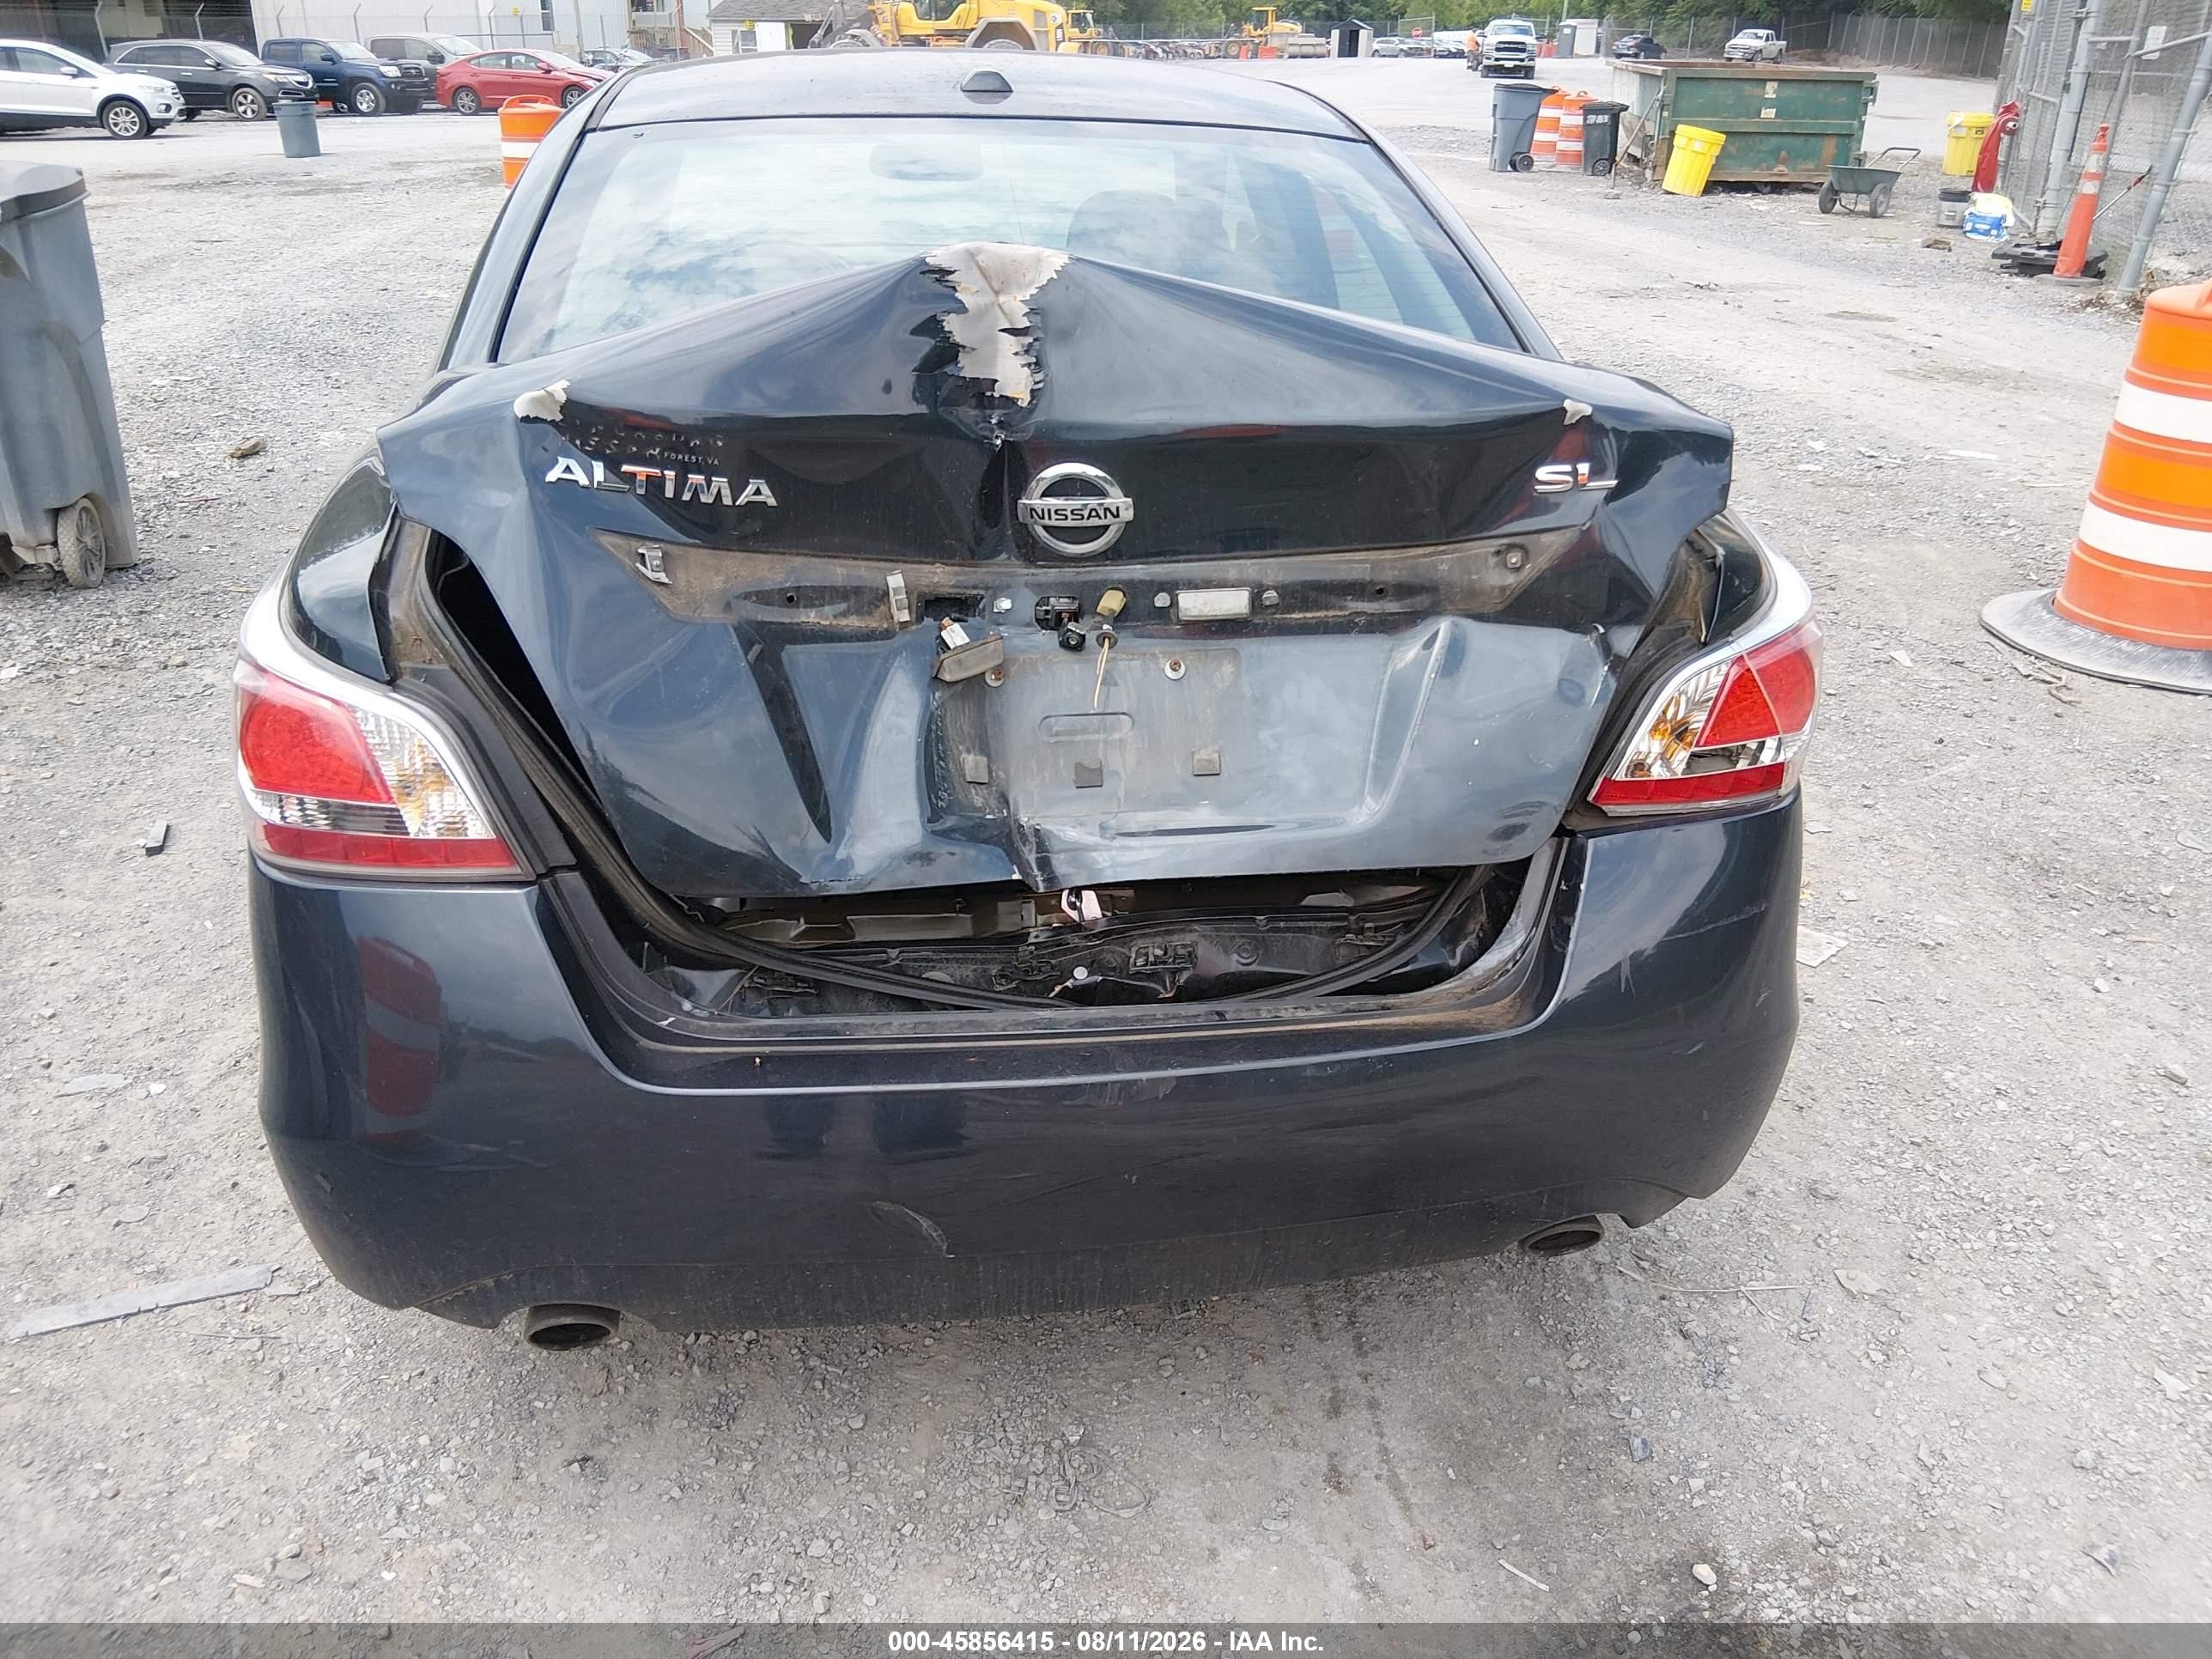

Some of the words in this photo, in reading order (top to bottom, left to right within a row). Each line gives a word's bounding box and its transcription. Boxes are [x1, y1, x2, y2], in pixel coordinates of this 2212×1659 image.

[545, 456, 778, 507] ALTIMA
[1534, 462, 1619, 493] SL
[1030, 506, 1121, 521] NISSAN
